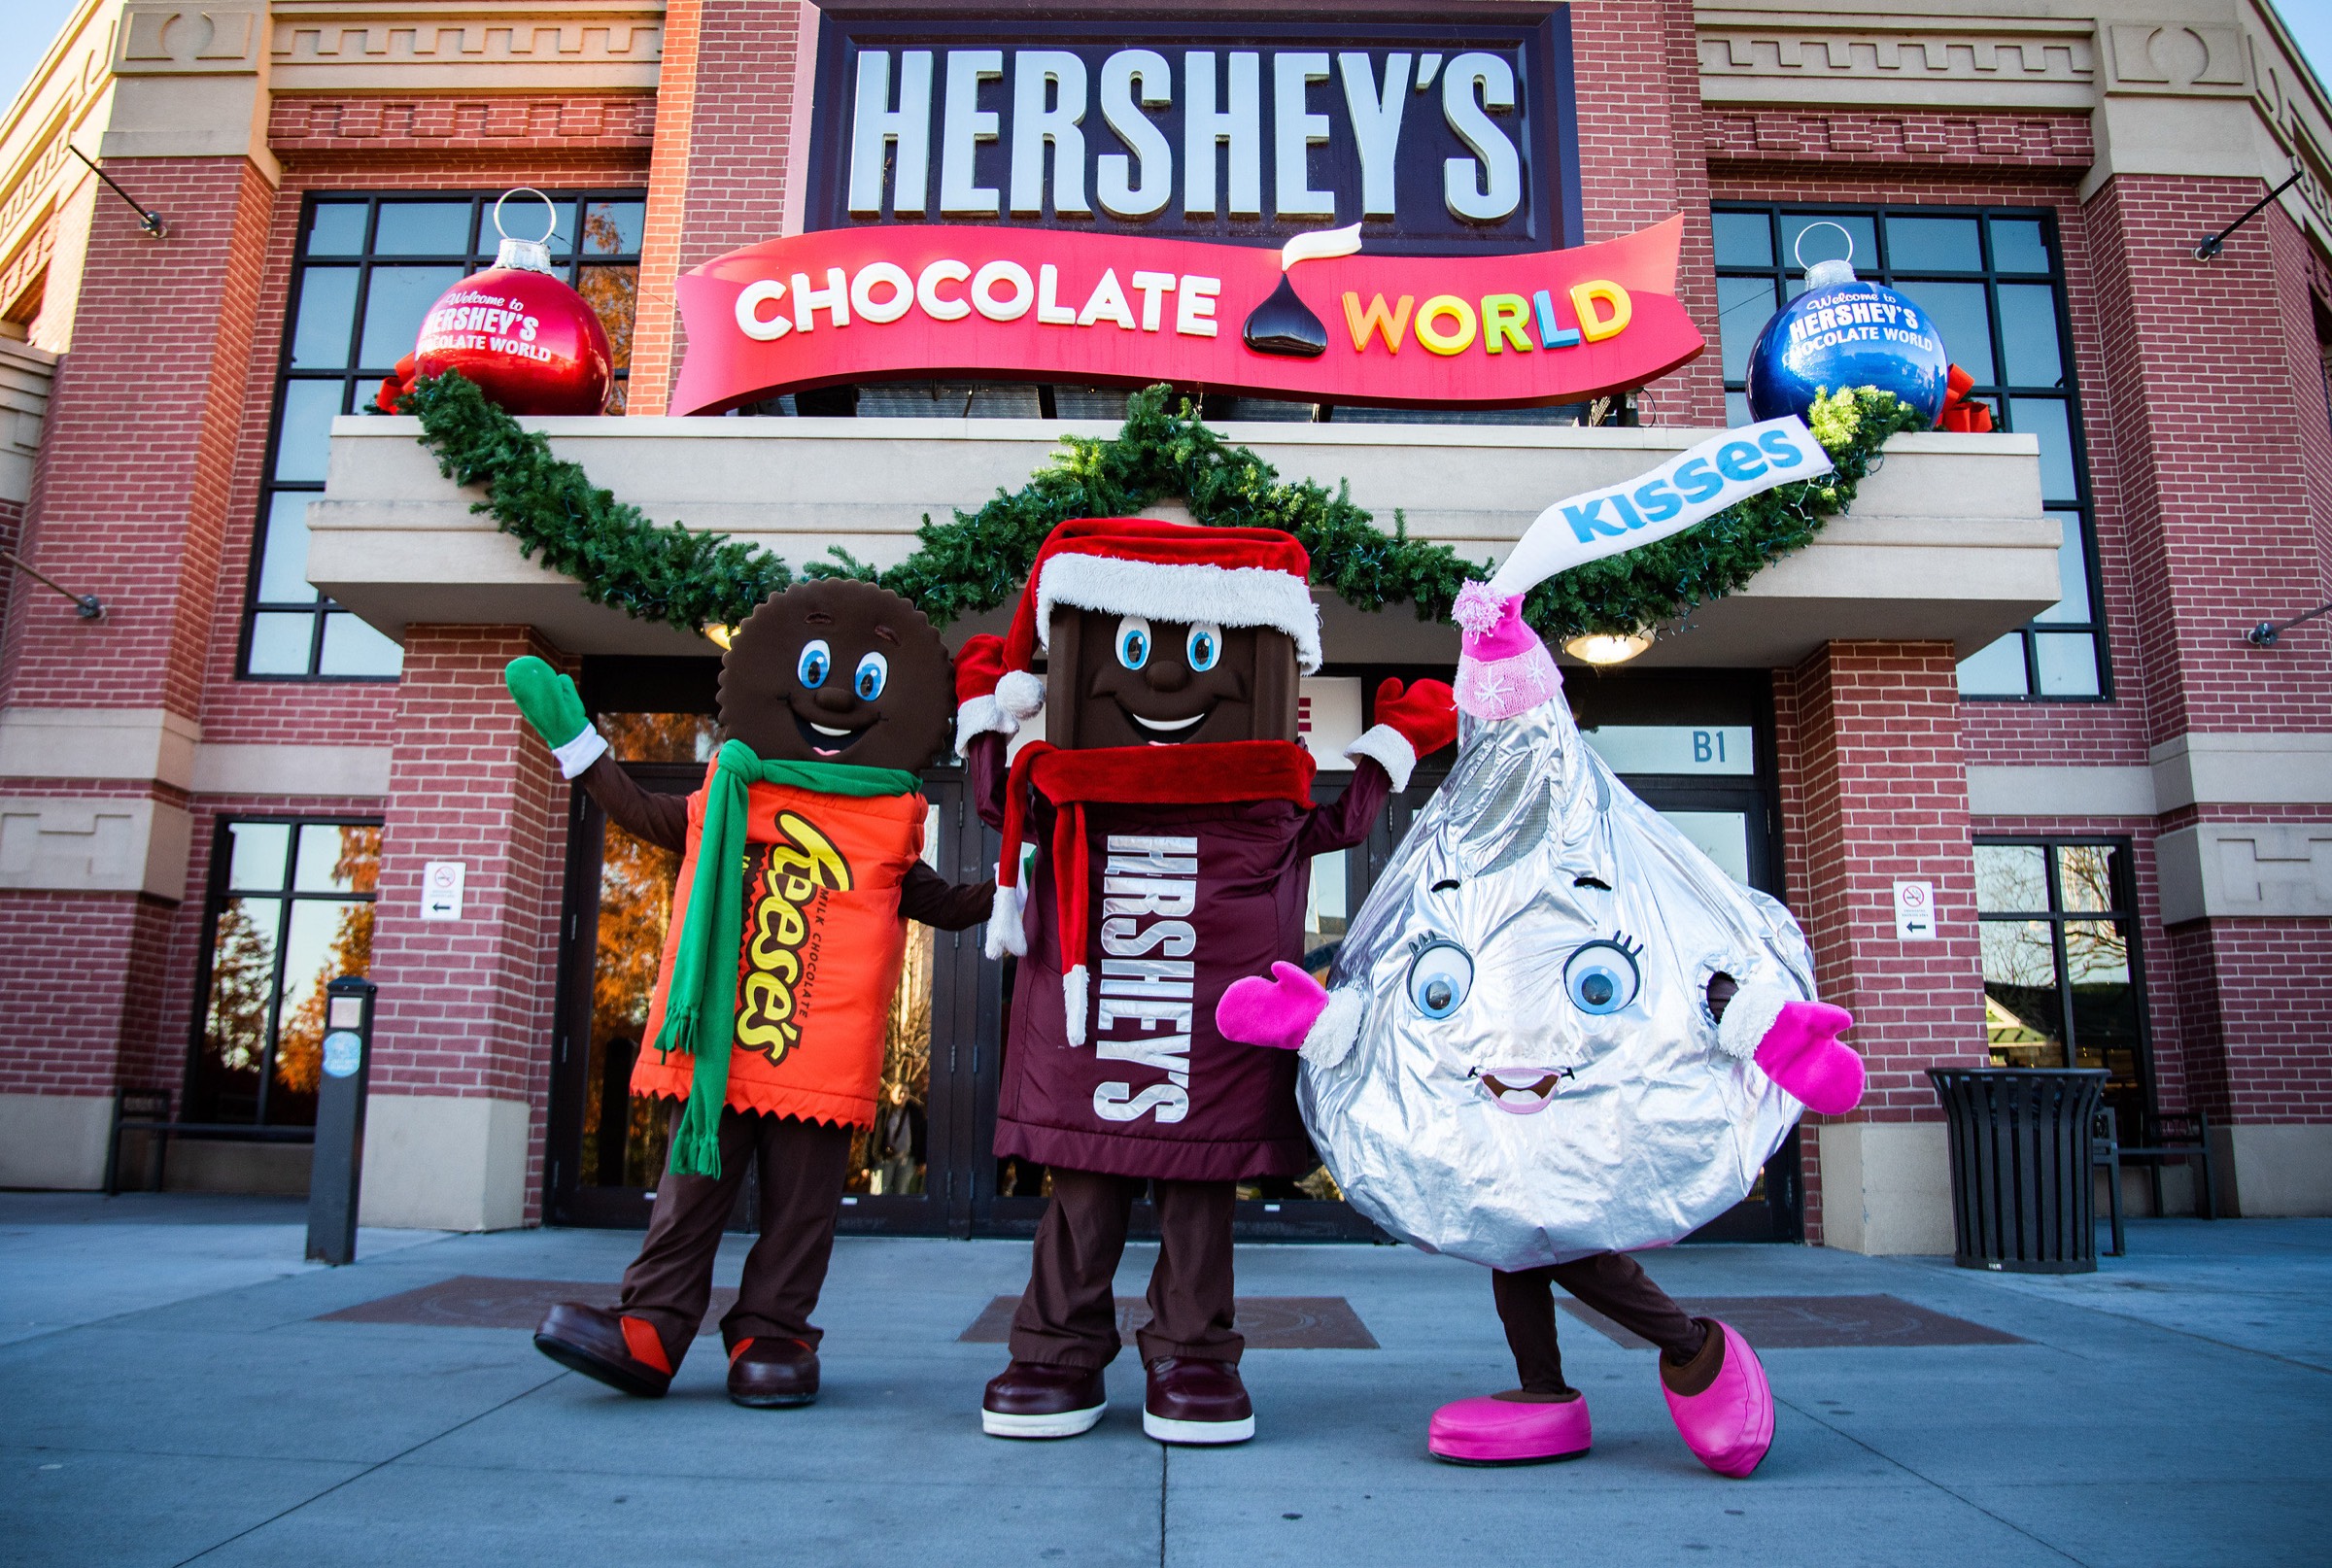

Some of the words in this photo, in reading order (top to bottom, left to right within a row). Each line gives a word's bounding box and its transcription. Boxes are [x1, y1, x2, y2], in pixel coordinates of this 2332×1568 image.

[848, 50, 1521, 224] HERSHEY'S
[447, 290, 505, 306] Welcome
[509, 298, 524, 311] to
[736, 259, 1221, 341] CHOCOLATE
[1342, 280, 1631, 355] WORLD
[1806, 292, 1879, 310] Welcome
[1883, 293, 1897, 303] to
[427, 307, 539, 342] ERSHEY'S
[1789, 302, 1919, 342] HERSHEY'S
[1883, 327, 1933, 352] WORLD
[420, 334, 486, 353] COLATE
[490, 336, 551, 362] WORLD
[1693, 731, 1726, 763] B1
[814, 888, 830, 926] MILK
[737, 810, 853, 1065] Reese's
[799, 932, 822, 1018] CHOCOLATE
